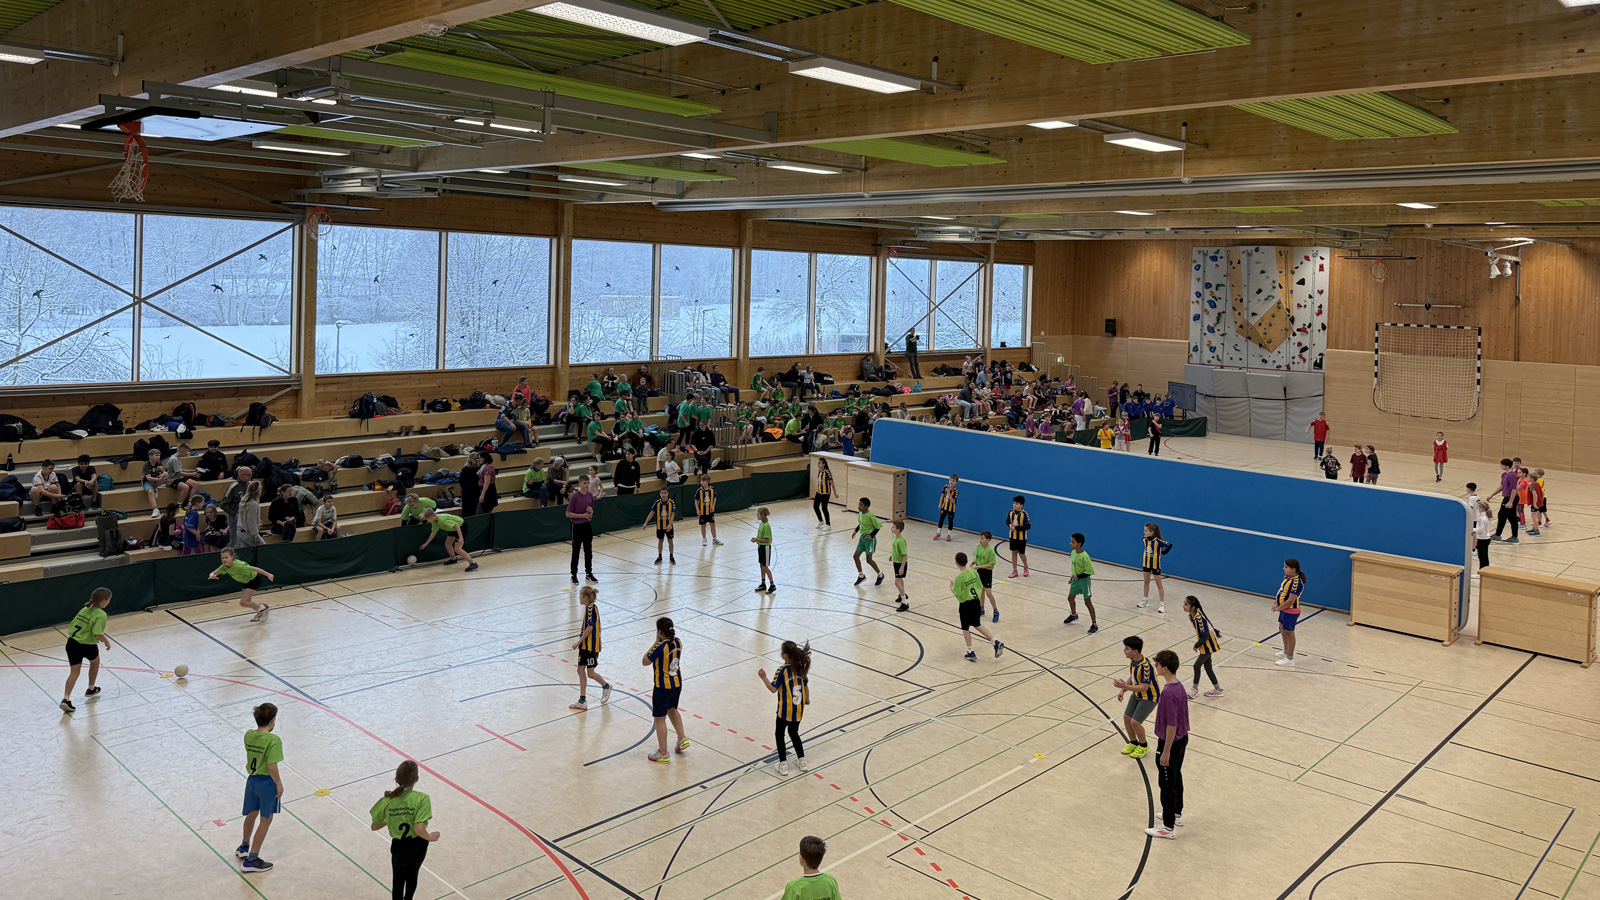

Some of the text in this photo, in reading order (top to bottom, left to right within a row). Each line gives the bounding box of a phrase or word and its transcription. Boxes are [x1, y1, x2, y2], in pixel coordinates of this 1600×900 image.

[970, 588, 978, 599] 9
[72, 625, 82, 637] 7
[587, 657, 595, 666] 10
[792, 685, 802, 705] 5
[398, 822, 412, 840] 2
